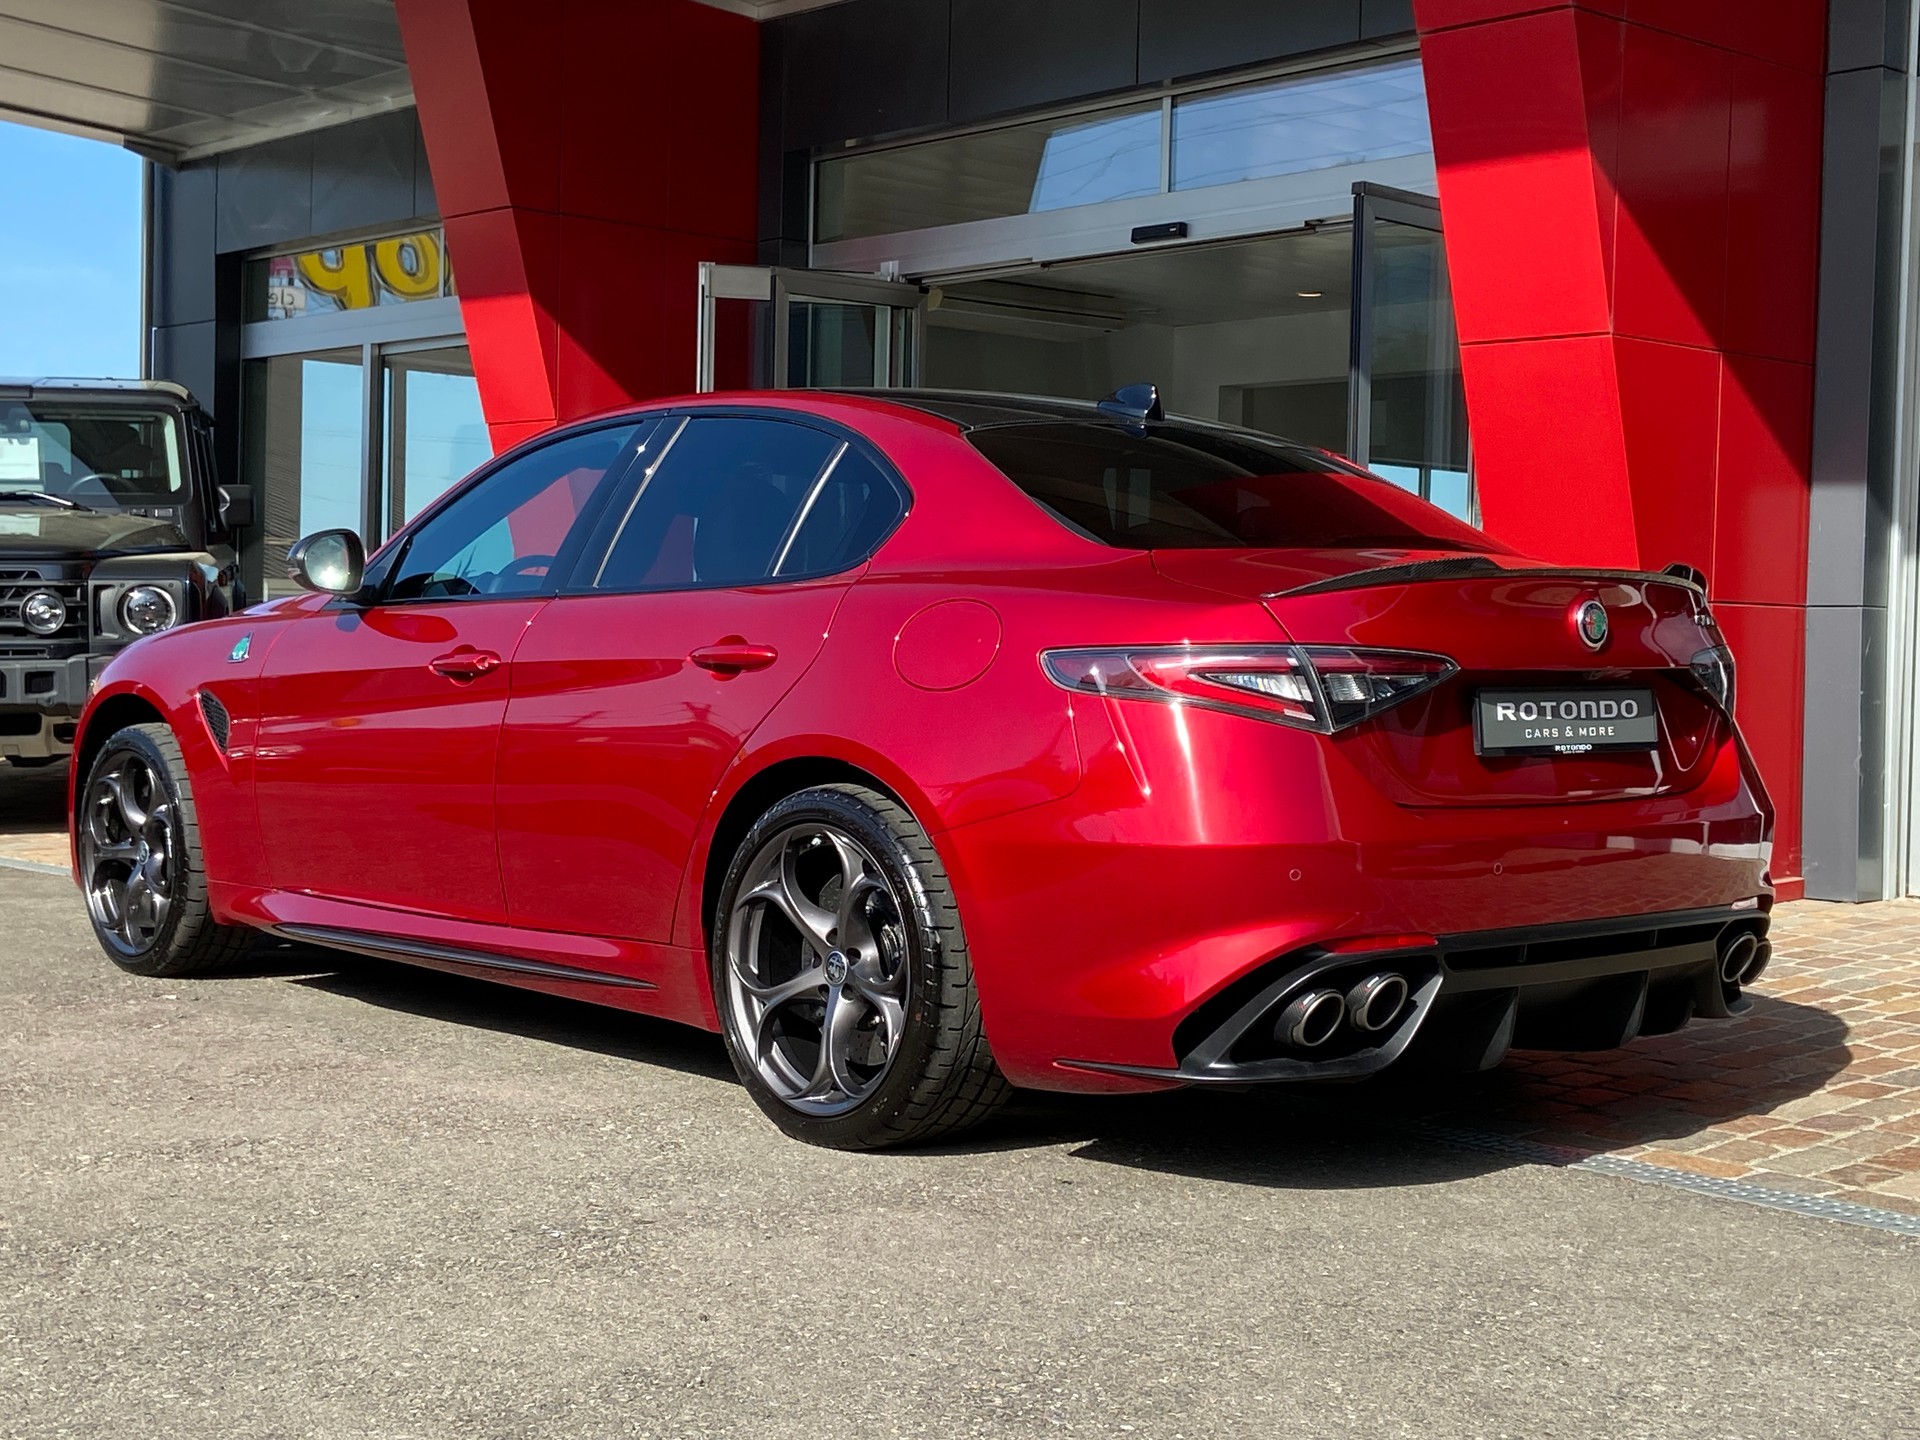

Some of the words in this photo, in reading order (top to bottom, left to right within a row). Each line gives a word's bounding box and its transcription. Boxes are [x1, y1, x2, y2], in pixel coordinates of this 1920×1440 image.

[1496, 700, 1639, 721] ROTONDO
[1525, 728, 1559, 739] CARS
[1564, 726, 1574, 737] &
[1578, 726, 1616, 737] MORE
